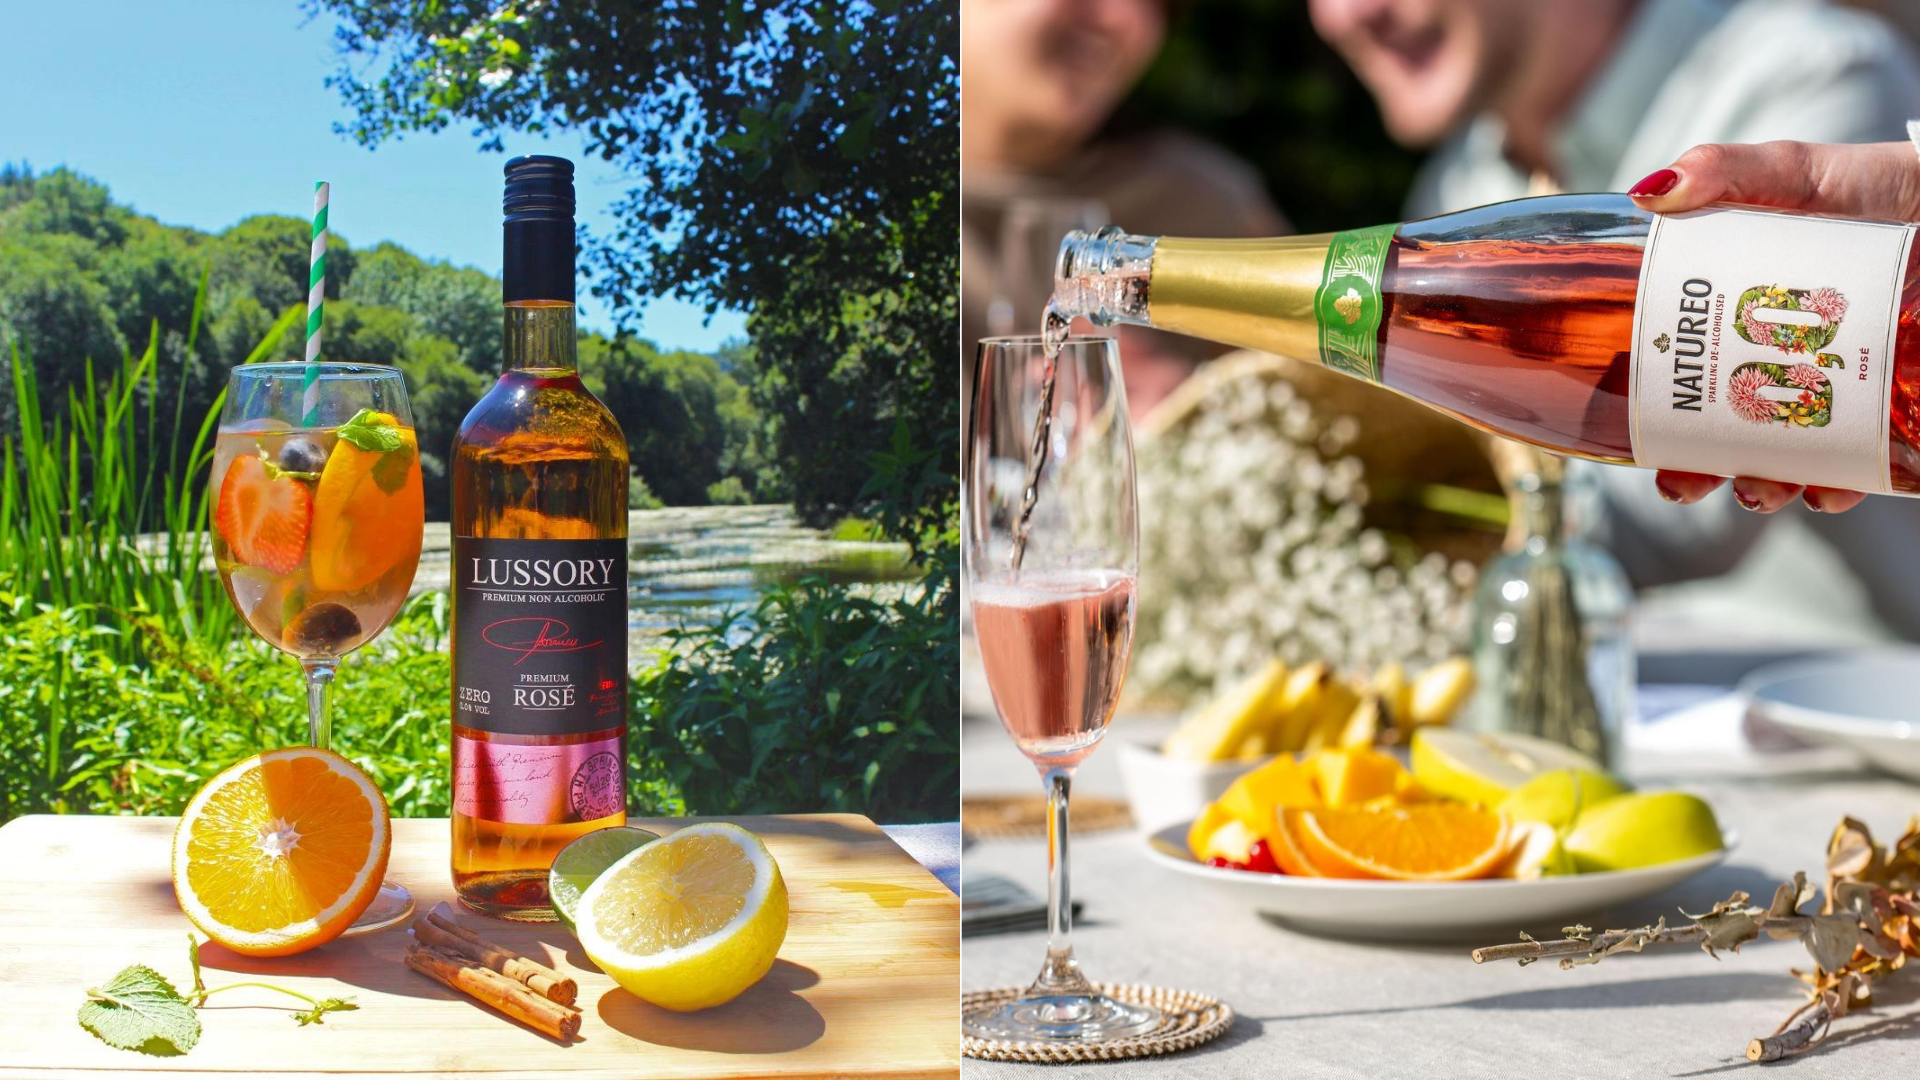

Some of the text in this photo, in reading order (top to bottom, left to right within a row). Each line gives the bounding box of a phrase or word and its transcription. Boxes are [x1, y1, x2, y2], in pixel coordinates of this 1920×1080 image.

[1672, 278, 1713, 412] NATUREO
[1708, 293, 1726, 404] SPARKLING DE-ALCOHOLISED
[1726, 284, 1849, 428] 0,0
[1858, 347, 1870, 381] ROSÉ
[472, 557, 615, 586] LUSSORY
[482, 592, 605, 603] PREMIUM NON ALCOHOLIC
[520, 674, 570, 683] PREMIUM
[459, 686, 491, 704] ZERO
[513, 684, 576, 707] ROSÉ
[474, 704, 491, 715] VOL
[525, 767, 554, 781] land
